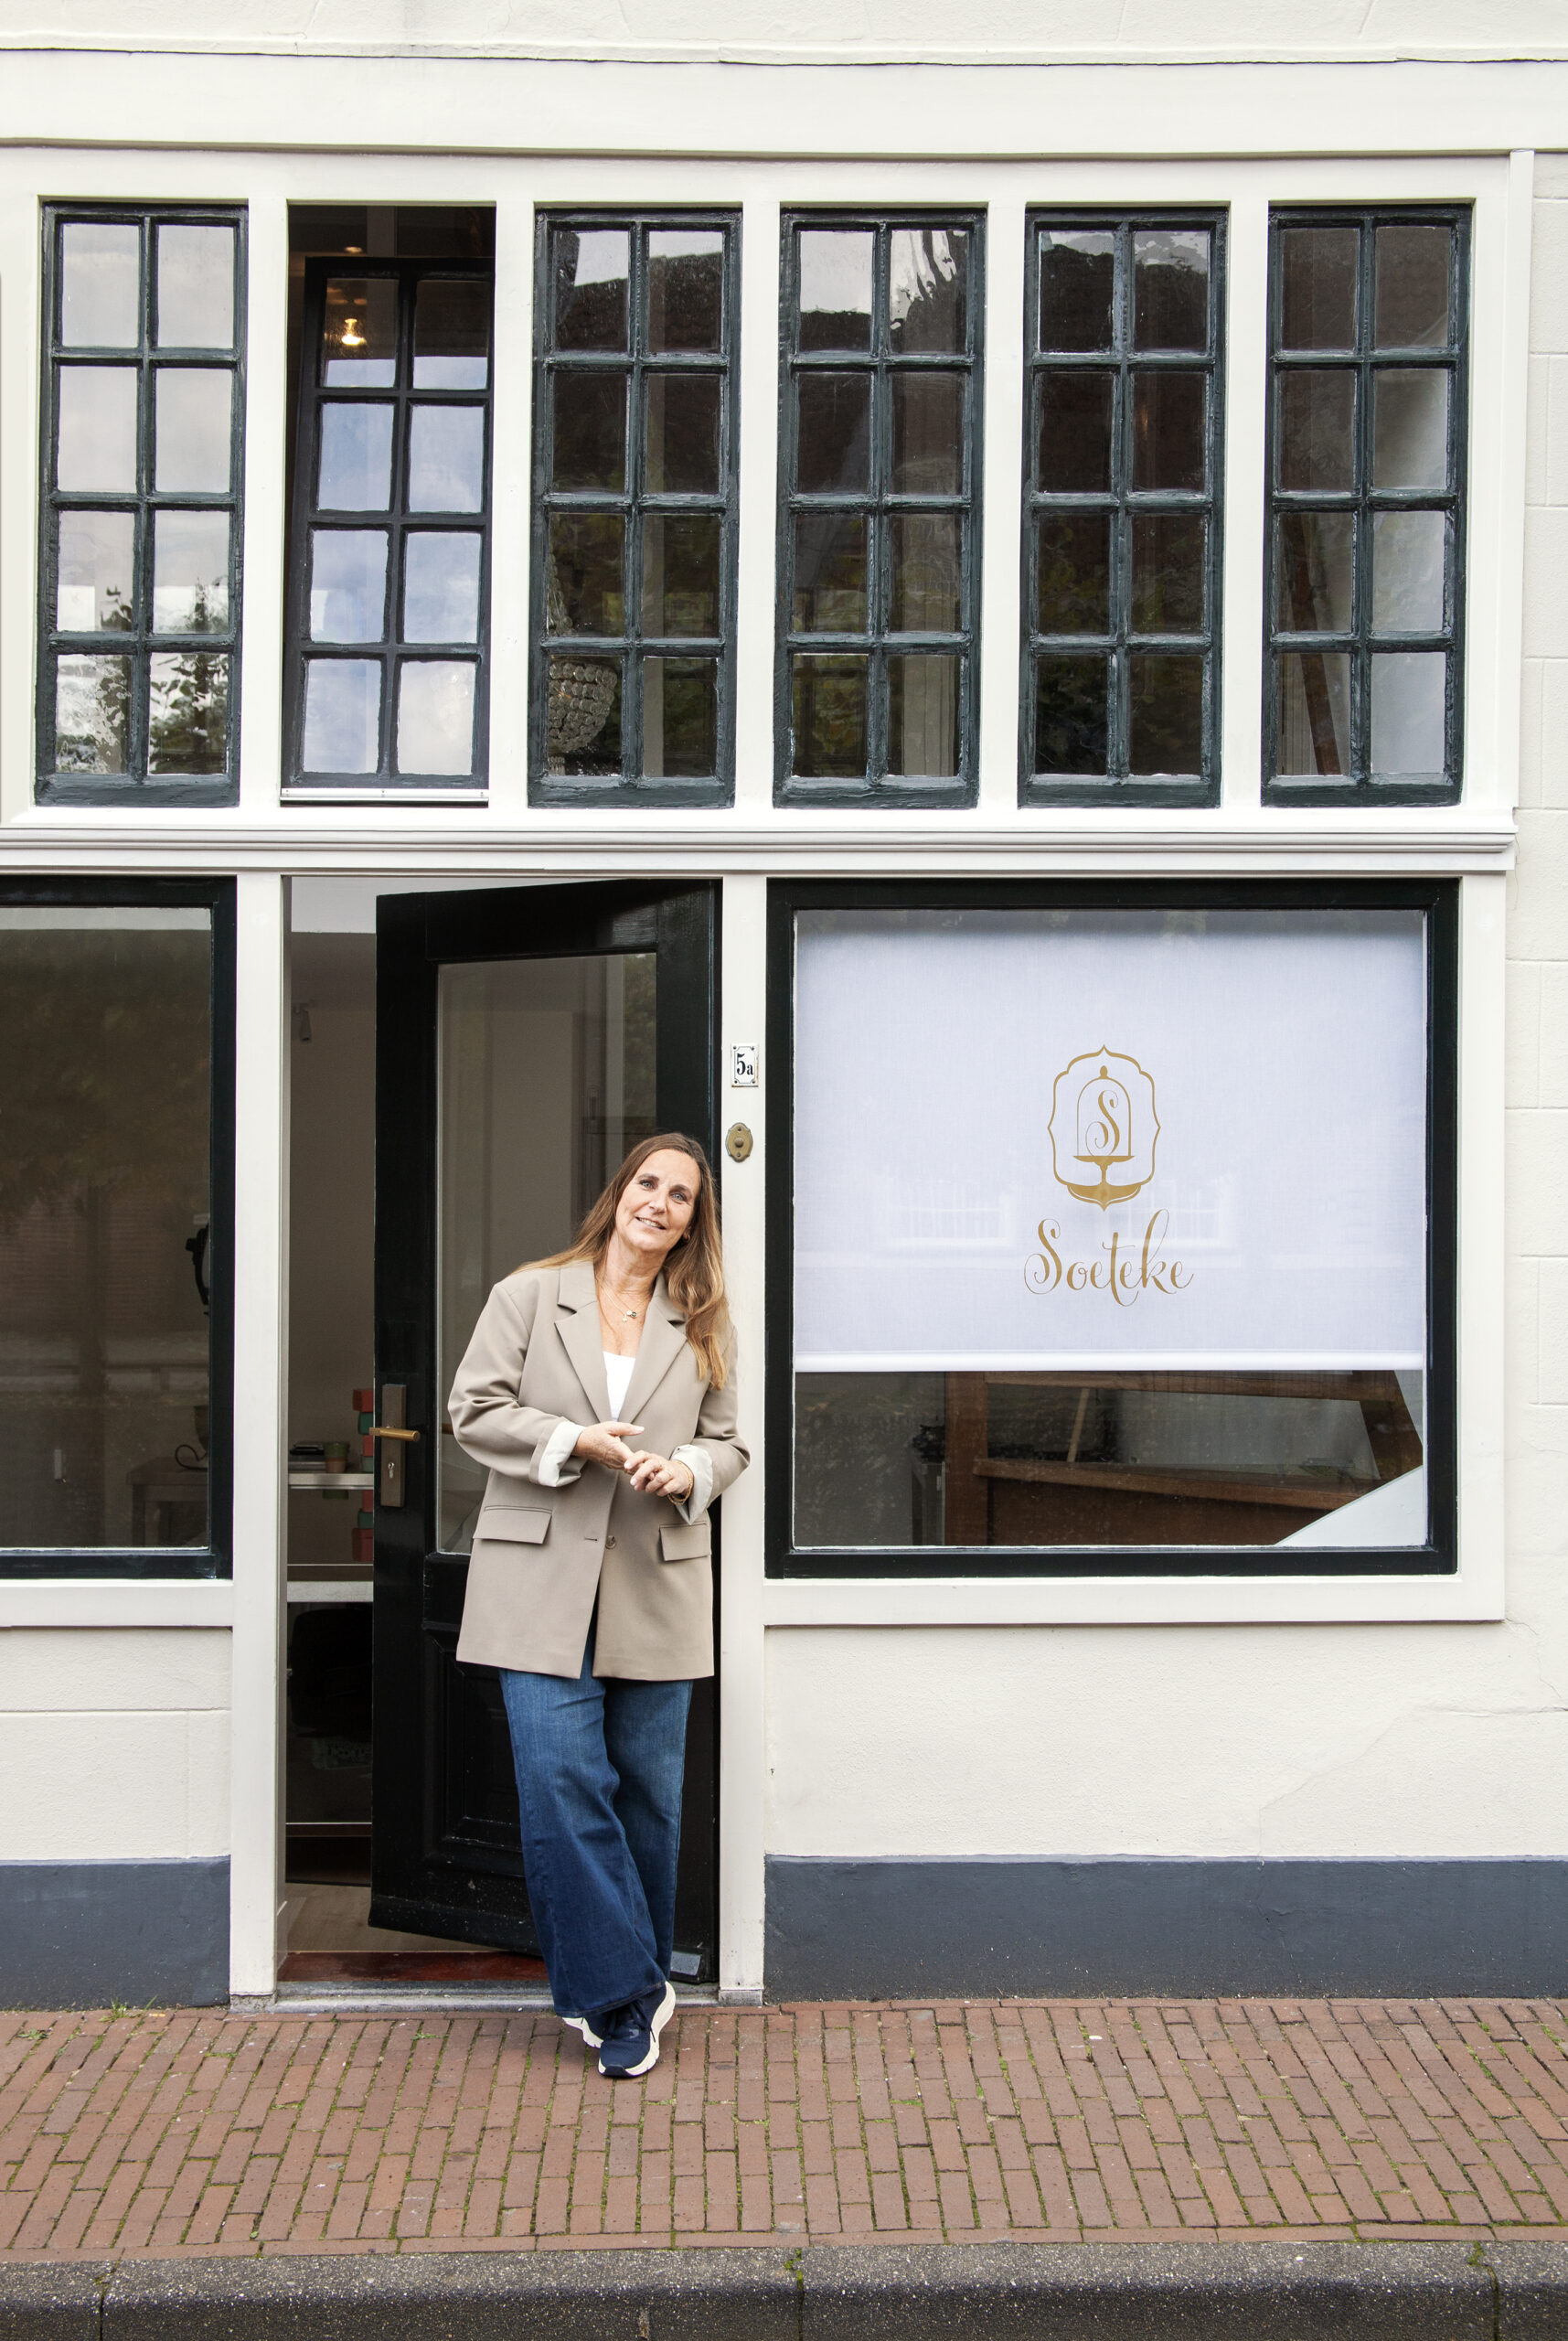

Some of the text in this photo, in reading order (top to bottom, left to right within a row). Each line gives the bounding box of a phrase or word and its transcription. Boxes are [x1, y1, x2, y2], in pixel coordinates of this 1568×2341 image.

[736, 1053, 754, 1075] 5a
[1085, 1090, 1120, 1157] S
[1023, 1208, 1194, 1307] Soeteke
